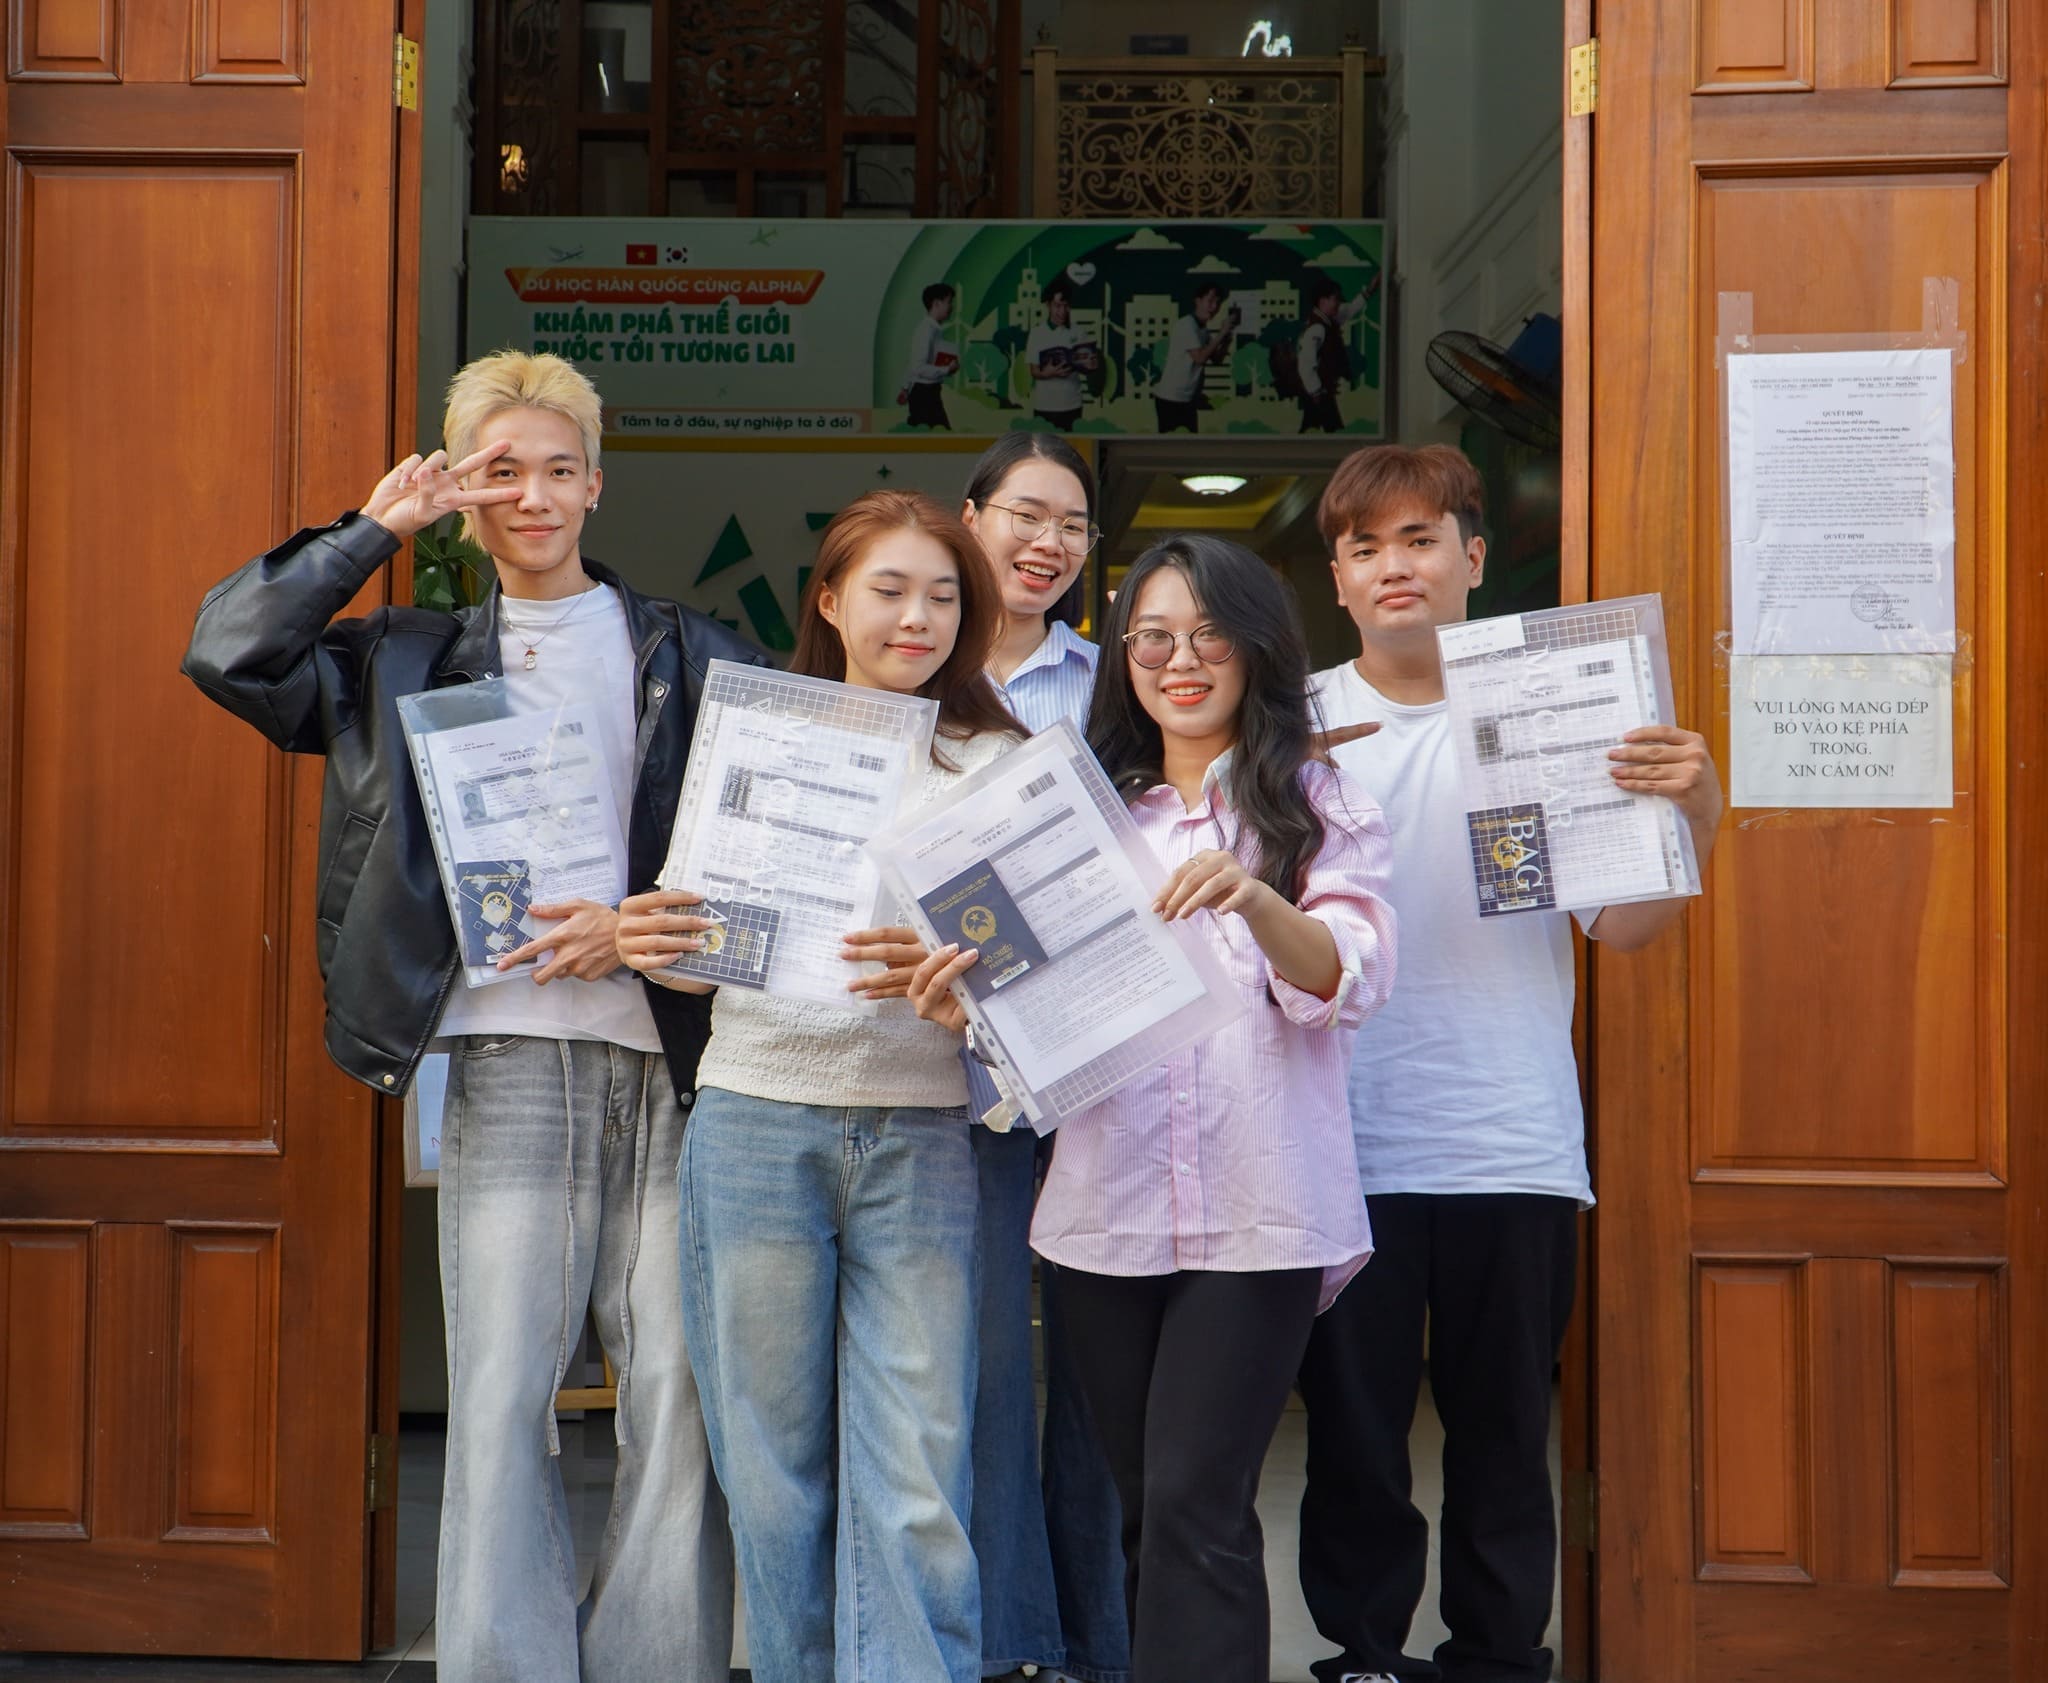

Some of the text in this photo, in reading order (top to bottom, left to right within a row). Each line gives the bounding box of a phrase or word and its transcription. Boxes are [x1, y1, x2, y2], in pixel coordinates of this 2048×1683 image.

[524, 274, 806, 295] DU HỌC HÀN QUỐC CÙNG ALPHA
[534, 300, 791, 335] KHÁM PHÁ THẾ GIỚI
[610, 335, 654, 362] TỚI
[660, 340, 749, 363] TƯƠNG
[756, 343, 795, 363] LAI
[621, 414, 652, 428] Tâm
[655, 415, 670, 428] ta
[724, 415, 742, 431] sự
[744, 415, 794, 431] nghiệp
[797, 416, 812, 429] ta
[830, 416, 853, 429] đó!
[1754, 697, 1929, 714] VUI LÒNG MANG DÉP
[1802, 718, 1838, 735] VÀO
[1843, 718, 1865, 738] KỆ
[1869, 717, 1909, 735] PHÍA
[1787, 764, 1816, 778] XIN
[1864, 763, 1895, 778] ƠN!
[1508, 816, 1543, 892] BAG
